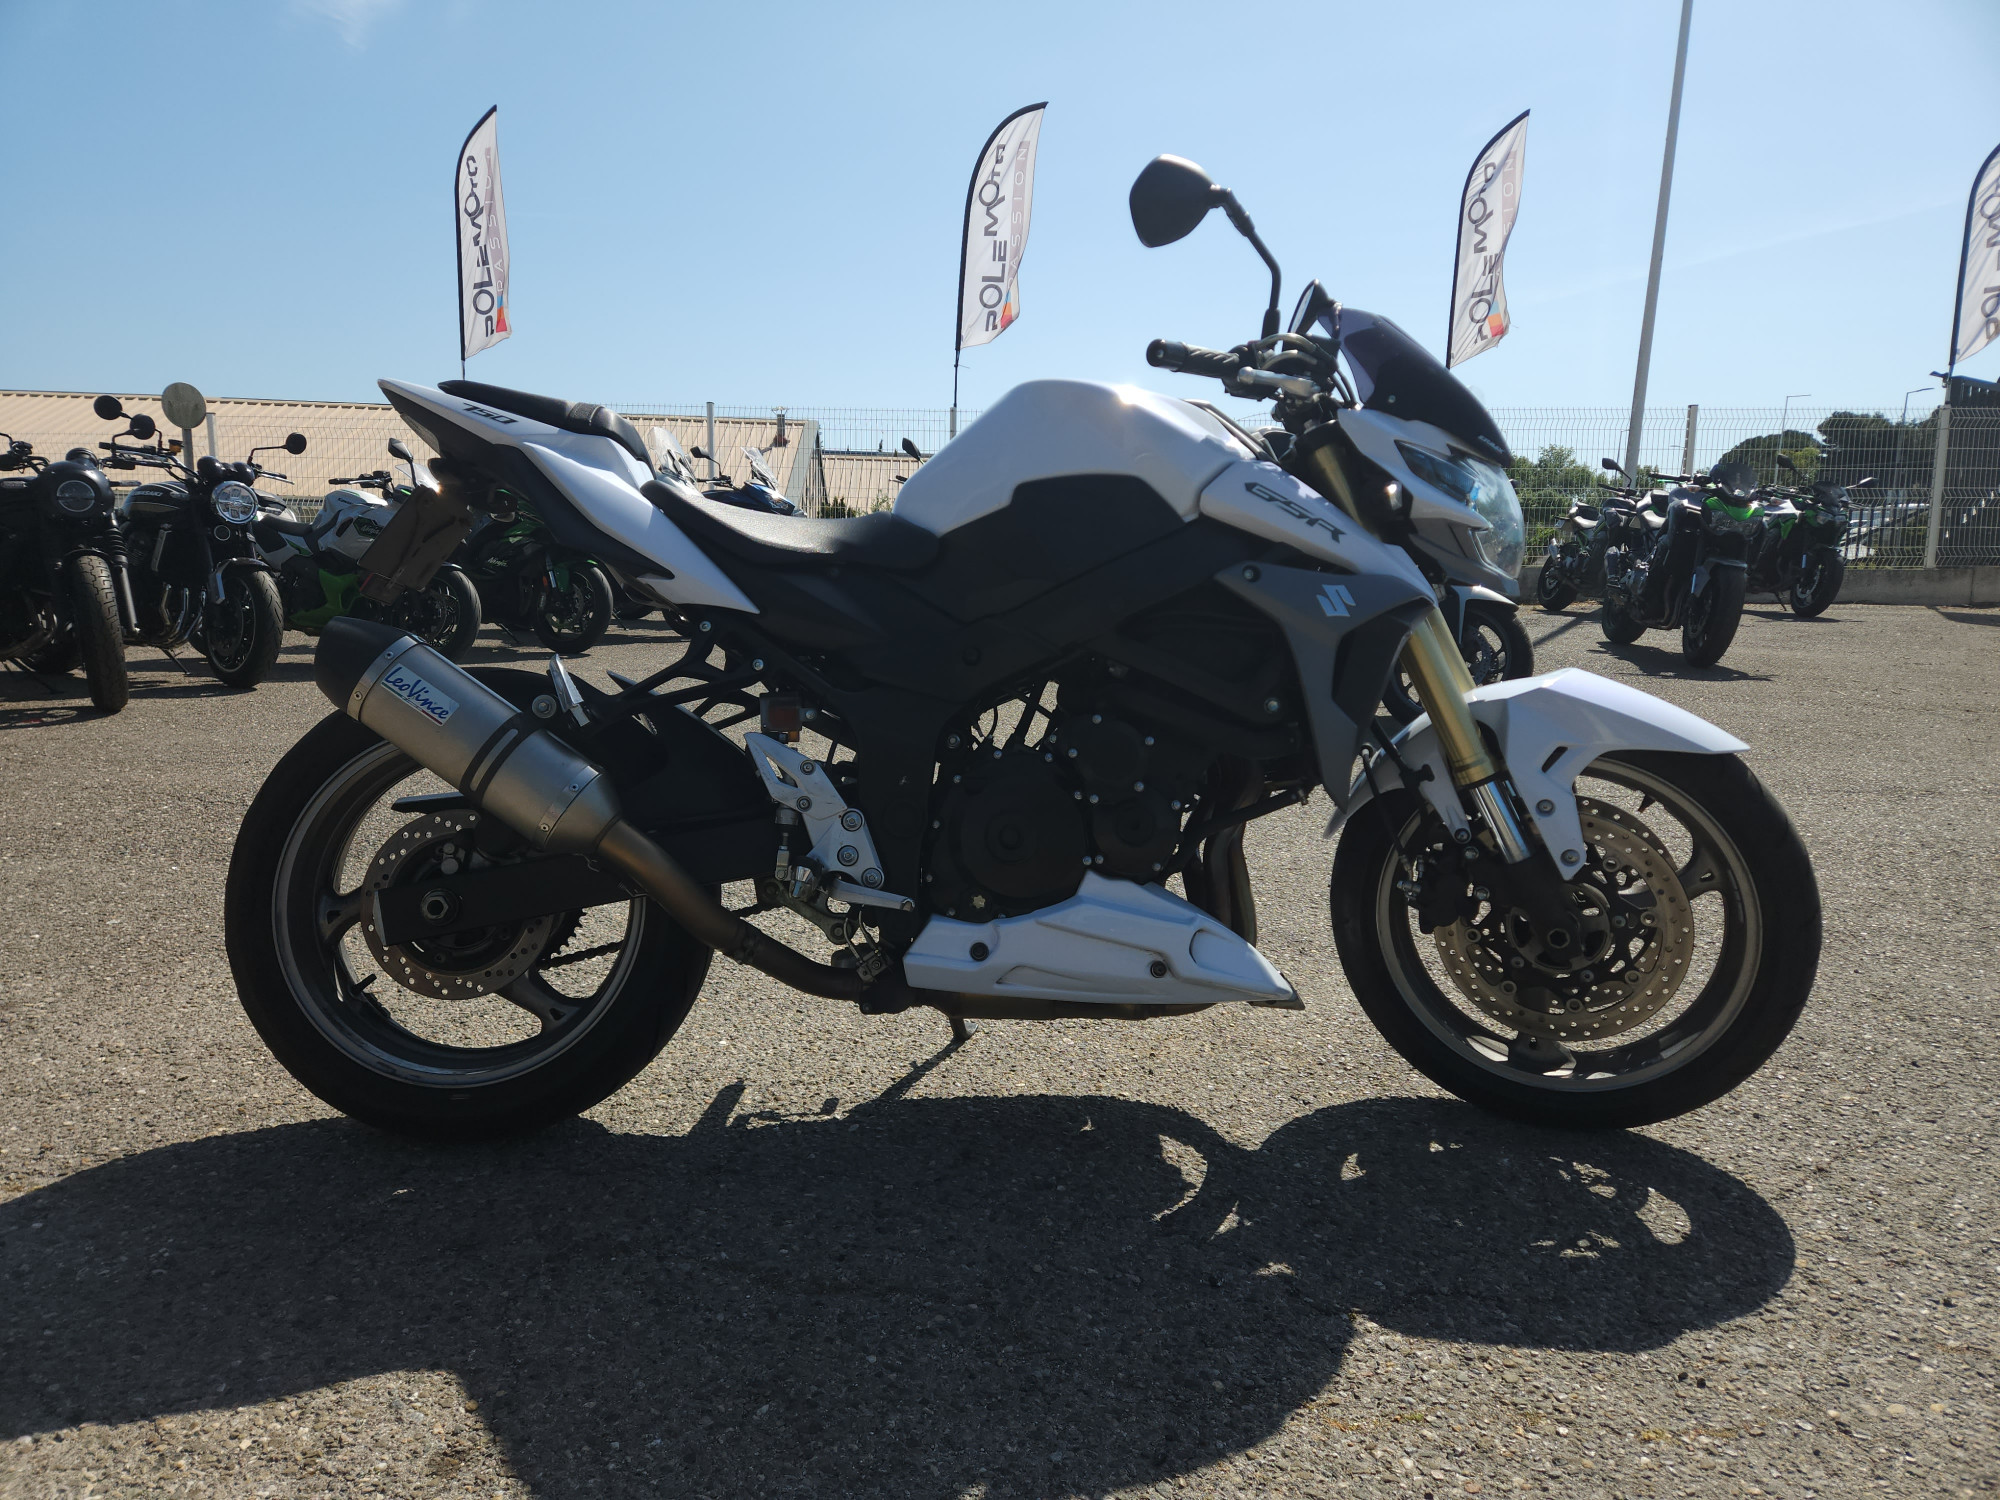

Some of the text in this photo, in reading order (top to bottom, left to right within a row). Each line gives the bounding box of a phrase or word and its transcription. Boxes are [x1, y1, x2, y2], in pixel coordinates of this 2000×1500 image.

[978, 239, 1008, 332] POLE
[463, 402, 519, 425] 750
[1244, 482, 1347, 544] GSR
[385, 666, 449, 719] LeoVince
